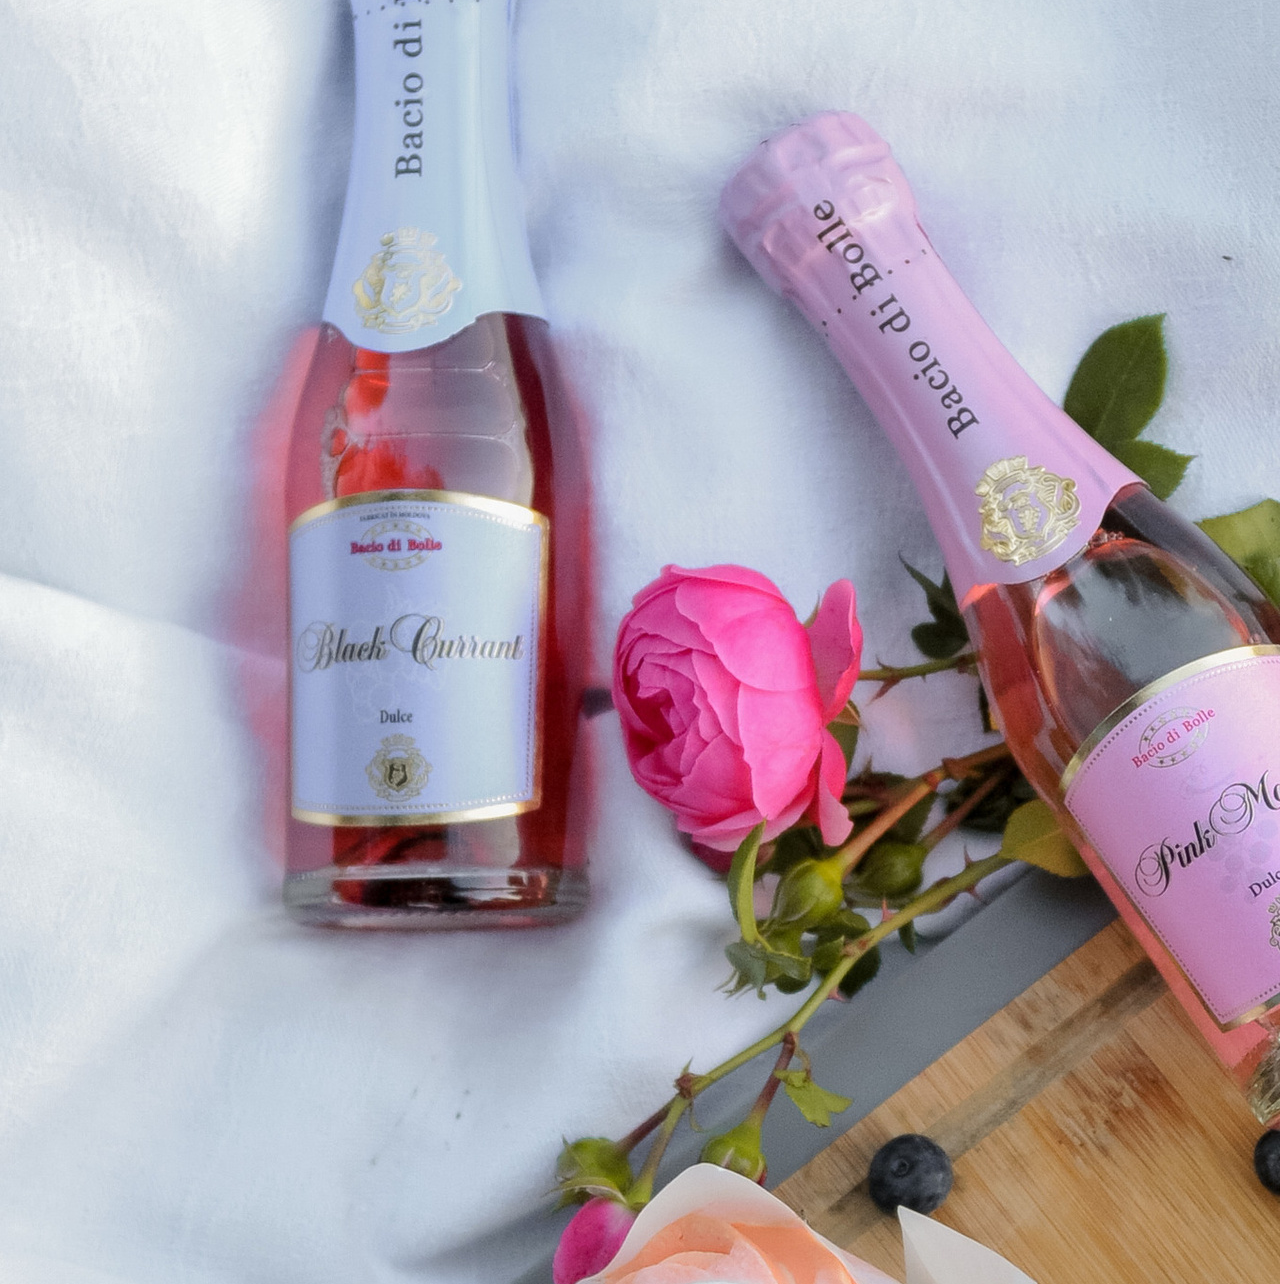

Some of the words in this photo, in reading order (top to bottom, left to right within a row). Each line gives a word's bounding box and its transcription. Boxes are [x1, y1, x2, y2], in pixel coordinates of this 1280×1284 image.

[393, 19, 423, 57] di
[394, 72, 424, 178] Bacio
[813, 198, 884, 295] Bolle
[870, 294, 912, 334] di
[908, 340, 980, 440] Bacio
[350, 540, 384, 555] Bacio
[387, 538, 402, 552] di
[407, 537, 443, 551] Bolle
[297, 620, 389, 673] Black
[390, 613, 526, 671] Currant
[379, 709, 414, 724] Dulce
[1131, 742, 1166, 769] Bacio
[1166, 728, 1181, 744] di
[1181, 708, 1216, 733] Bolle
[1134, 820, 1216, 898] Pink
